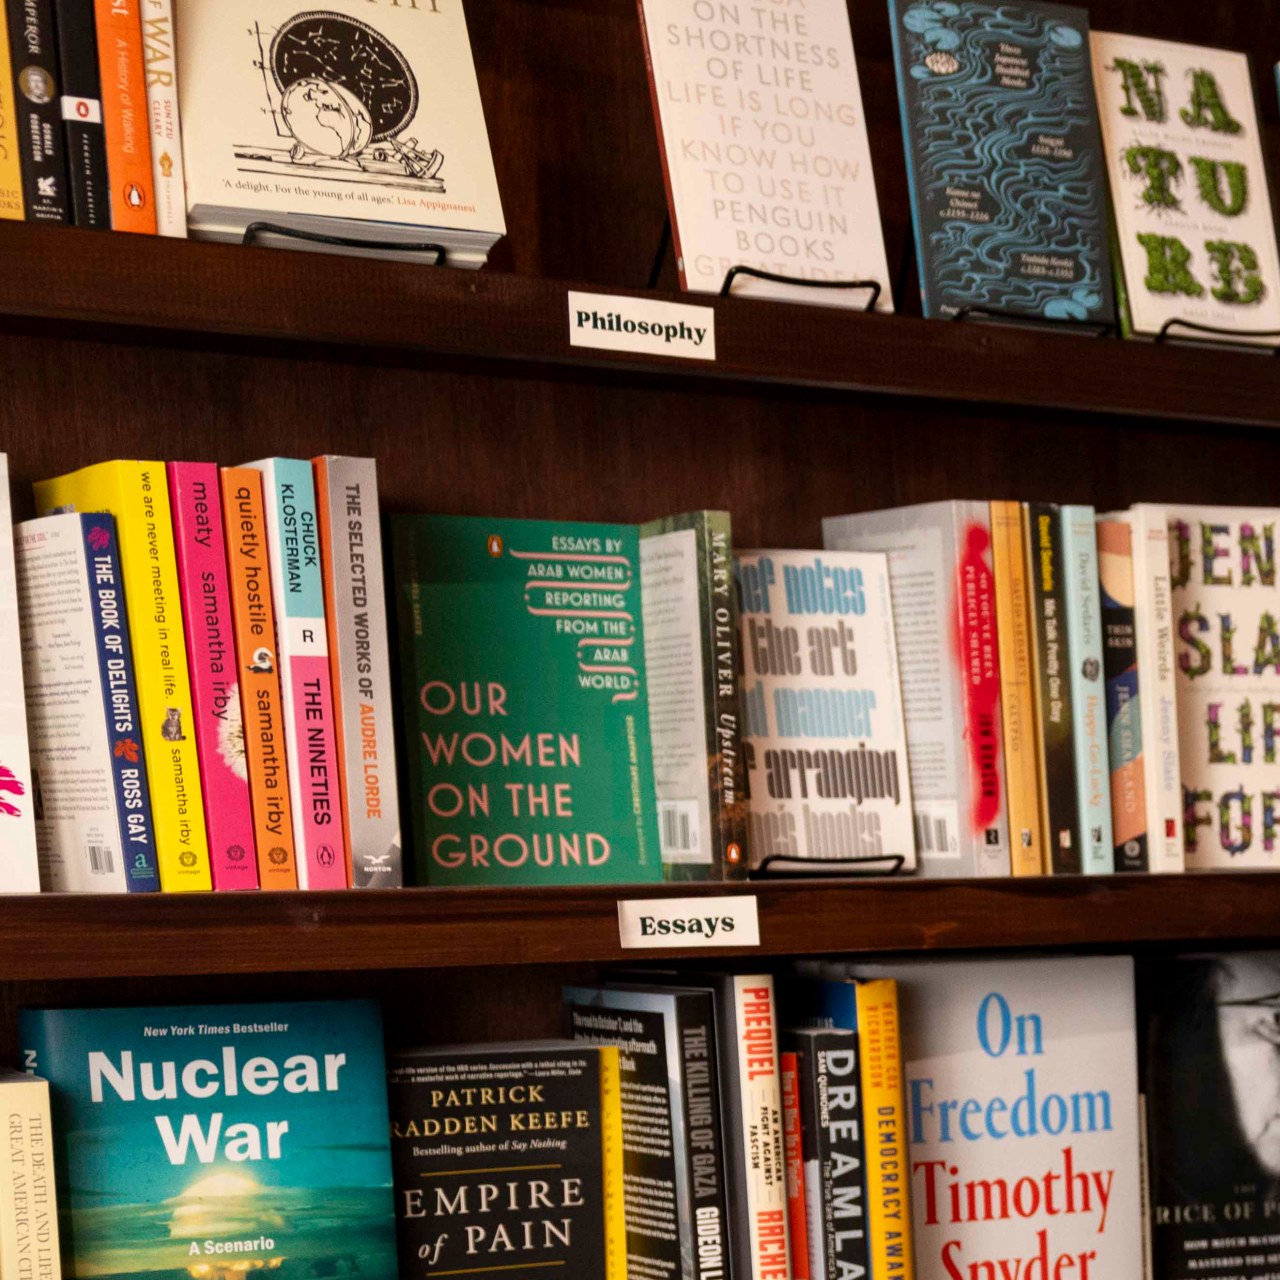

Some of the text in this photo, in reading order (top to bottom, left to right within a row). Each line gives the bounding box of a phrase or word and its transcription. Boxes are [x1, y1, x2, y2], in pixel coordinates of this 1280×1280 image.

[144, 16, 172, 88] WAR
[667, 24, 840, 69] SHORTNESS
[153, 100, 161, 137] CLEARY
[398, 196, 476, 214] Lisa Appignanesi
[714, 199, 848, 236] PENGUIN
[736, 230, 834, 263] BOOKS
[576, 311, 707, 346] Philosophy
[280, 483, 302, 594] KLOSTERMAN
[552, 536, 622, 553] ESSAYS BY
[141, 472, 174, 699] we are never meeting in real life.
[527, 562, 624, 581] ARAB WOMEN
[193, 481, 229, 721] meaty samantha irby
[236, 486, 283, 836] quietly hostile samantha irby
[711, 531, 737, 805] MARY OLIVER Upstream
[93, 555, 147, 845] THE BOOK OF DELIGHTS ROSS GAY
[420, 680, 507, 716] OUR
[303, 678, 331, 826] THE NINETIES
[422, 733, 581, 767] WOMEN
[428, 783, 573, 817] ON THE
[431, 832, 611, 868] GROUND
[640, 914, 735, 937] Essays
[741, 987, 774, 1082] PREQUEL
[977, 992, 1045, 1058] On
[88, 1046, 346, 1102] Nuclear
[431, 1084, 545, 1108] PATRICK
[909, 1069, 1114, 1144] Freedom
[154, 1112, 289, 1166] War
[876, 1105, 902, 1222] DEMOCRACY
[403, 1178, 586, 1220] EMPIRE
[914, 1147, 1115, 1233] Timothy
[418, 1218, 573, 1262] of PAIN
